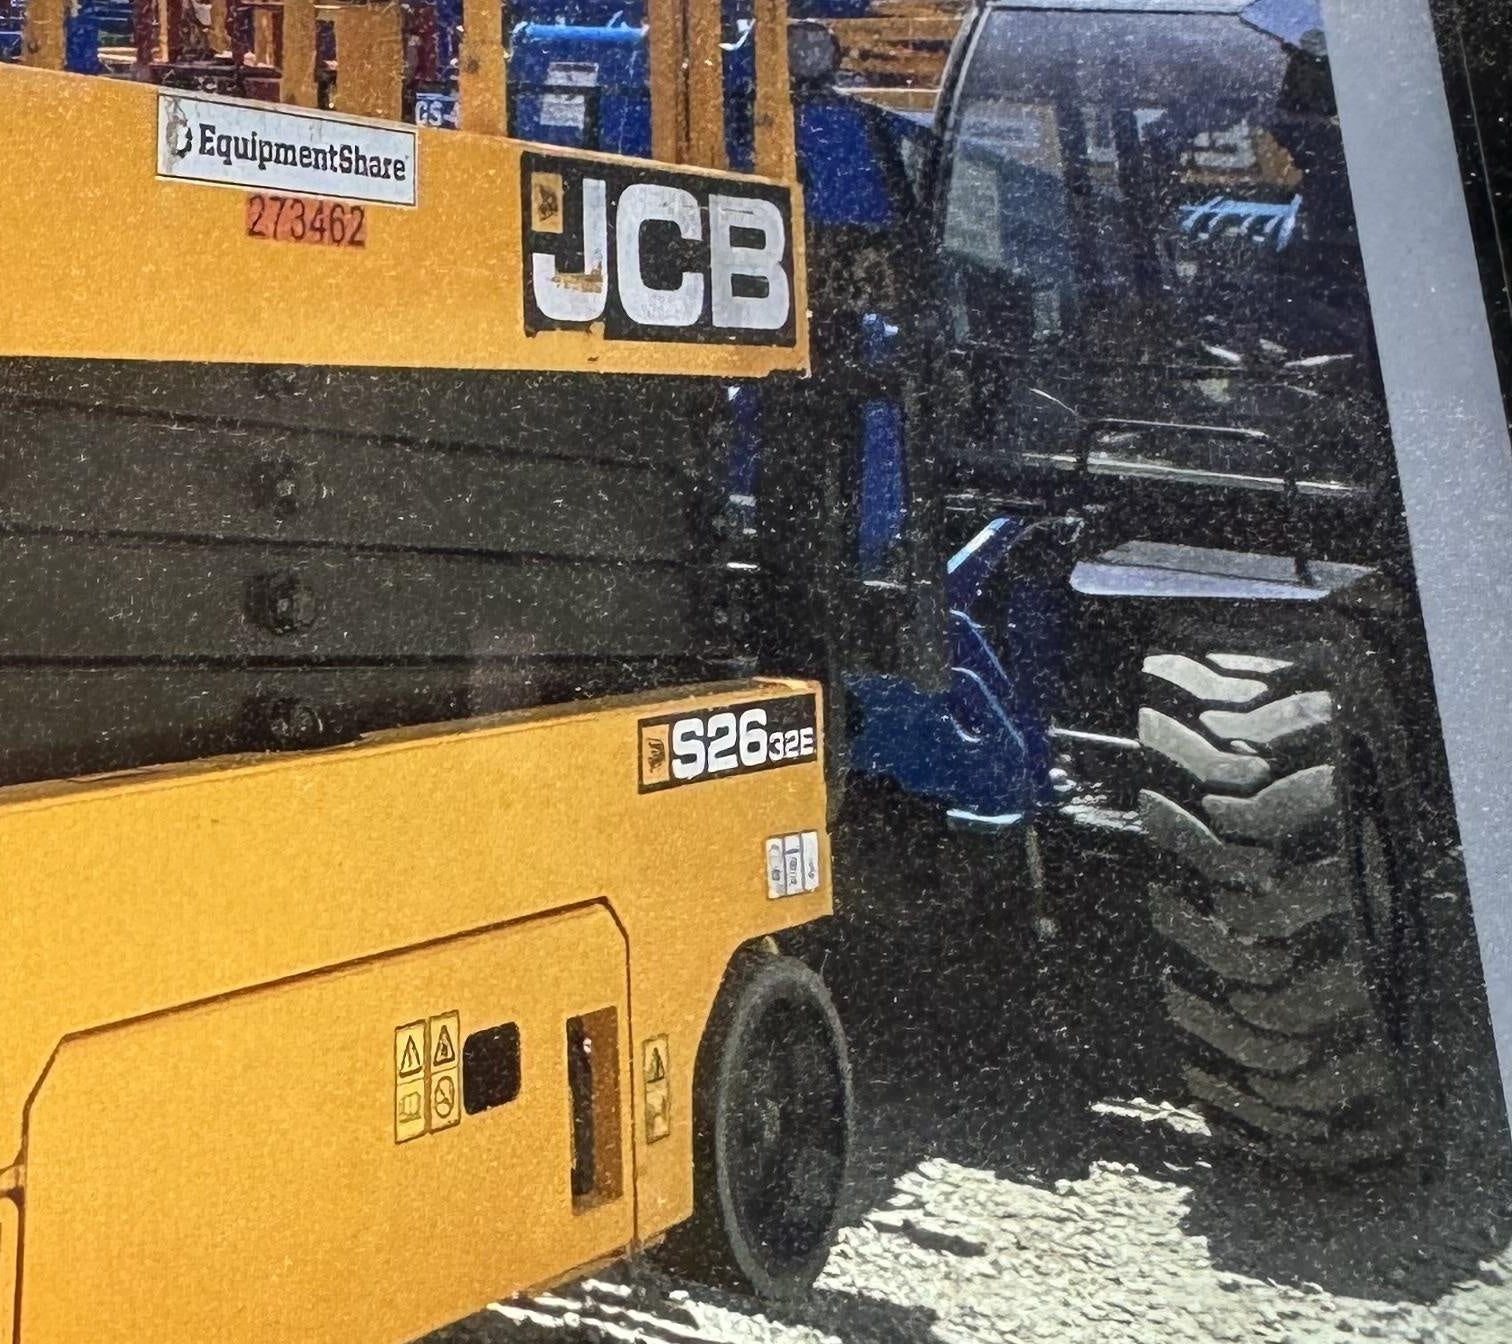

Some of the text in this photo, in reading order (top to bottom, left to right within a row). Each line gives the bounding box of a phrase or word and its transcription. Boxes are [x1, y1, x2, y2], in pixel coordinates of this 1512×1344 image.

[198, 122, 407, 182] EquipmentShare
[247, 194, 366, 246] 273462
[531, 177, 790, 330] JCB
